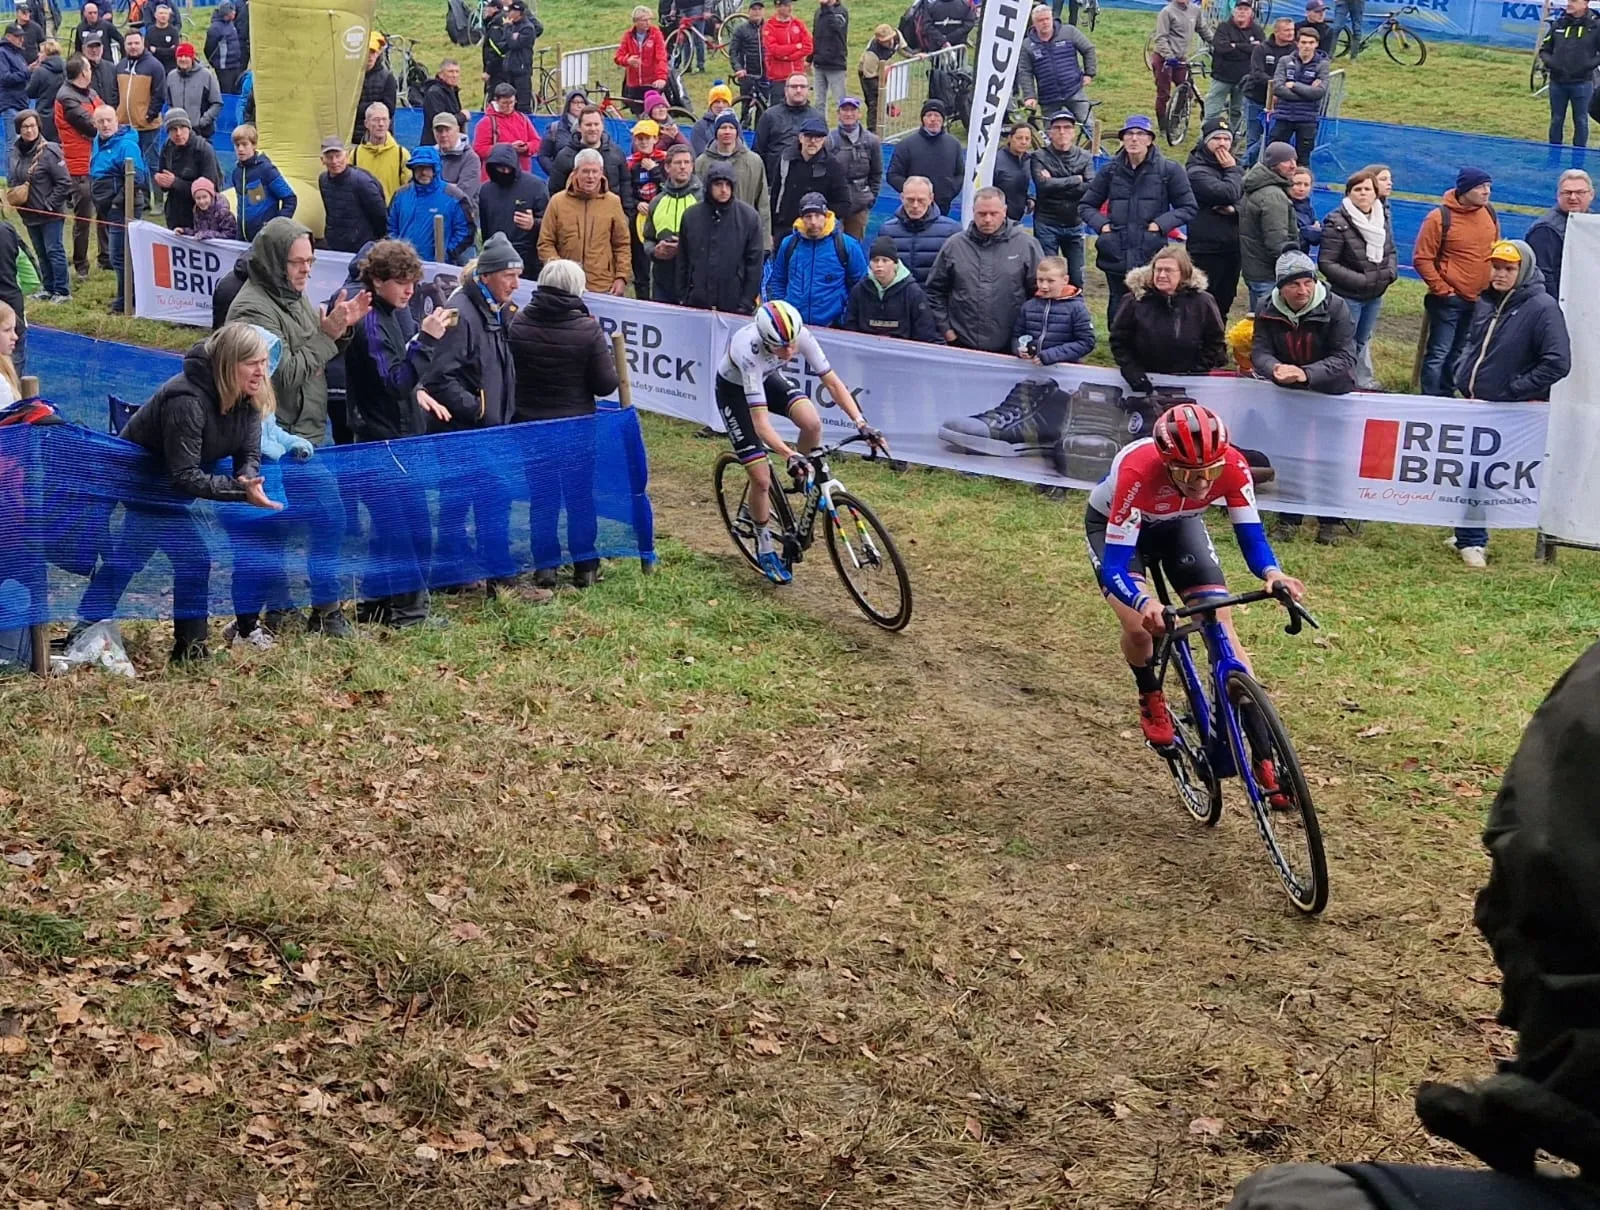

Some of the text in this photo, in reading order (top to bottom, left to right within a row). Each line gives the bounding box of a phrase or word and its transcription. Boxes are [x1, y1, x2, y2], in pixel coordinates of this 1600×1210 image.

[171, 246, 220, 273] RED
[173, 270, 219, 296] BRI
[607, 345, 696, 385] RICK
[1402, 421, 1502, 457] RED
[1398, 455, 1542, 490] BRICK
[1358, 488, 1377, 499] The
[1382, 489, 1436, 506] Original
[1112, 573, 1134, 598] TREK
